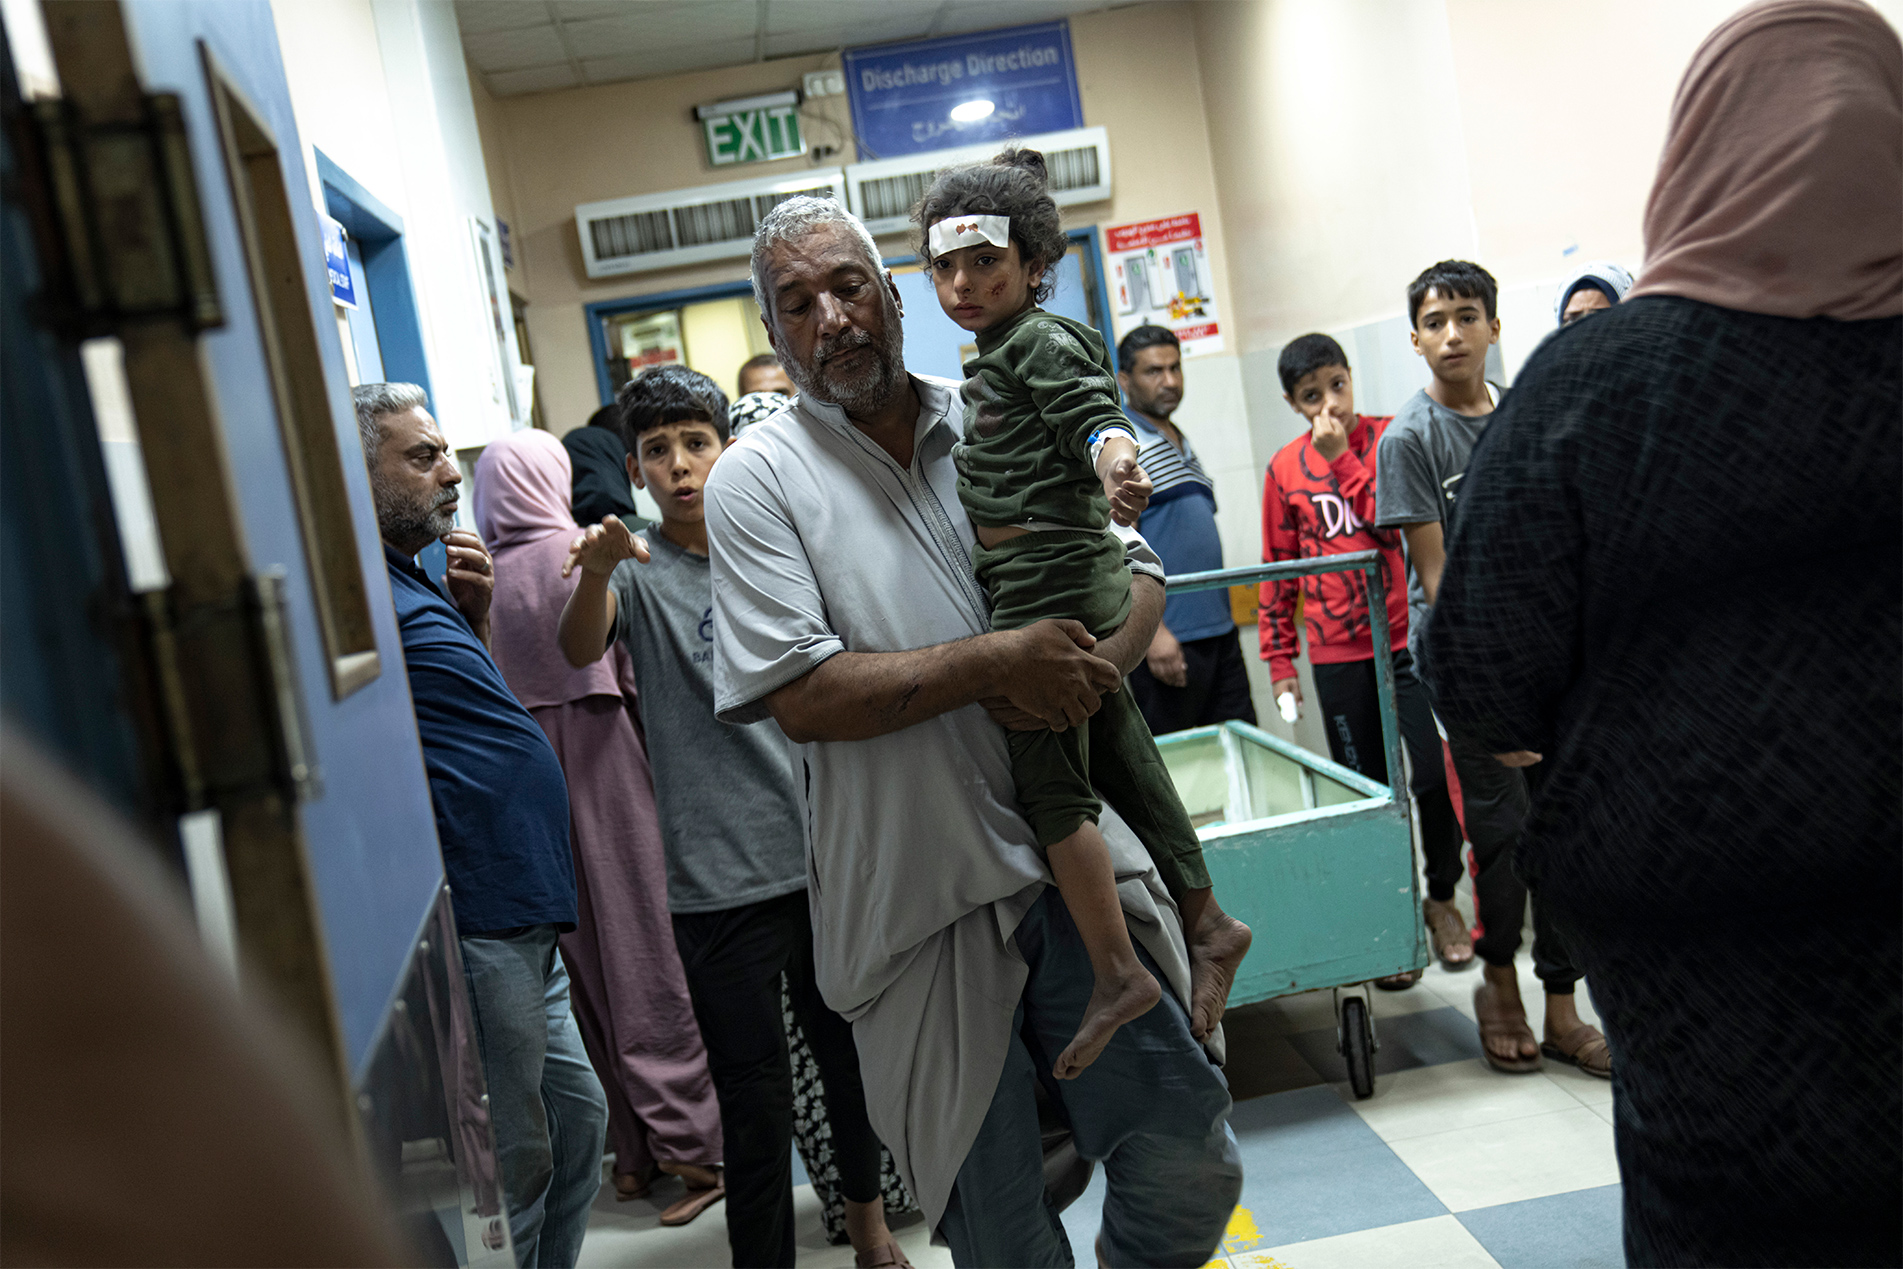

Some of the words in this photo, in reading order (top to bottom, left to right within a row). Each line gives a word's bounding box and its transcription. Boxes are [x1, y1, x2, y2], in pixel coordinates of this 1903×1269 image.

[861, 60, 964, 92] Discharge
[966, 44, 1060, 76] Direction
[706, 107, 793, 165] EXIT
